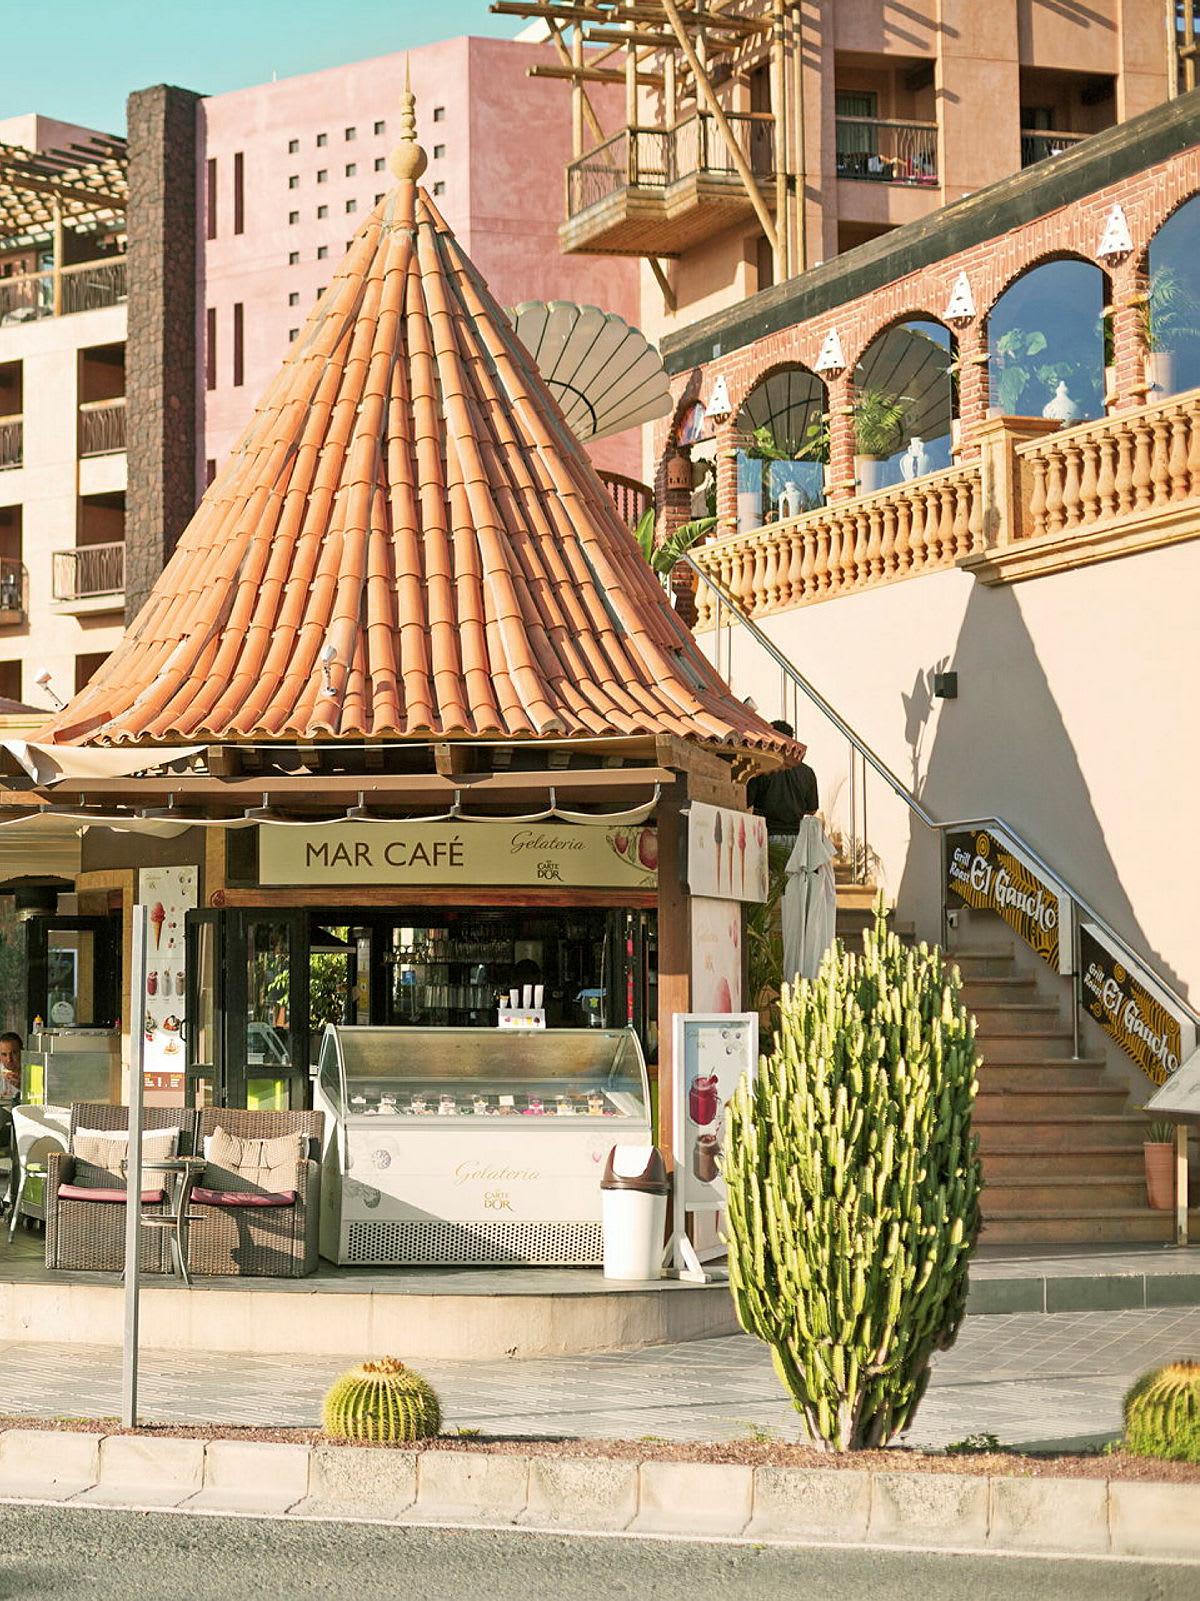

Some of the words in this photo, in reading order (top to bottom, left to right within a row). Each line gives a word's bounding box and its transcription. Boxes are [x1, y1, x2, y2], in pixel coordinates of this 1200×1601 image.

[306, 842, 372, 866] MAR
[384, 835, 464, 866] CAFÉ
[511, 830, 585, 853] Gelateria
[537, 862, 559, 870] CARTE
[954, 847, 971, 868] Grill
[971, 855, 993, 895] El
[995, 868, 1057, 933] Gaucho
[1089, 963, 1105, 983] Grill
[1103, 978, 1124, 1016] El
[1124, 1000, 1178, 1074] Gaucho
[454, 1159, 540, 1187] Gelateria
